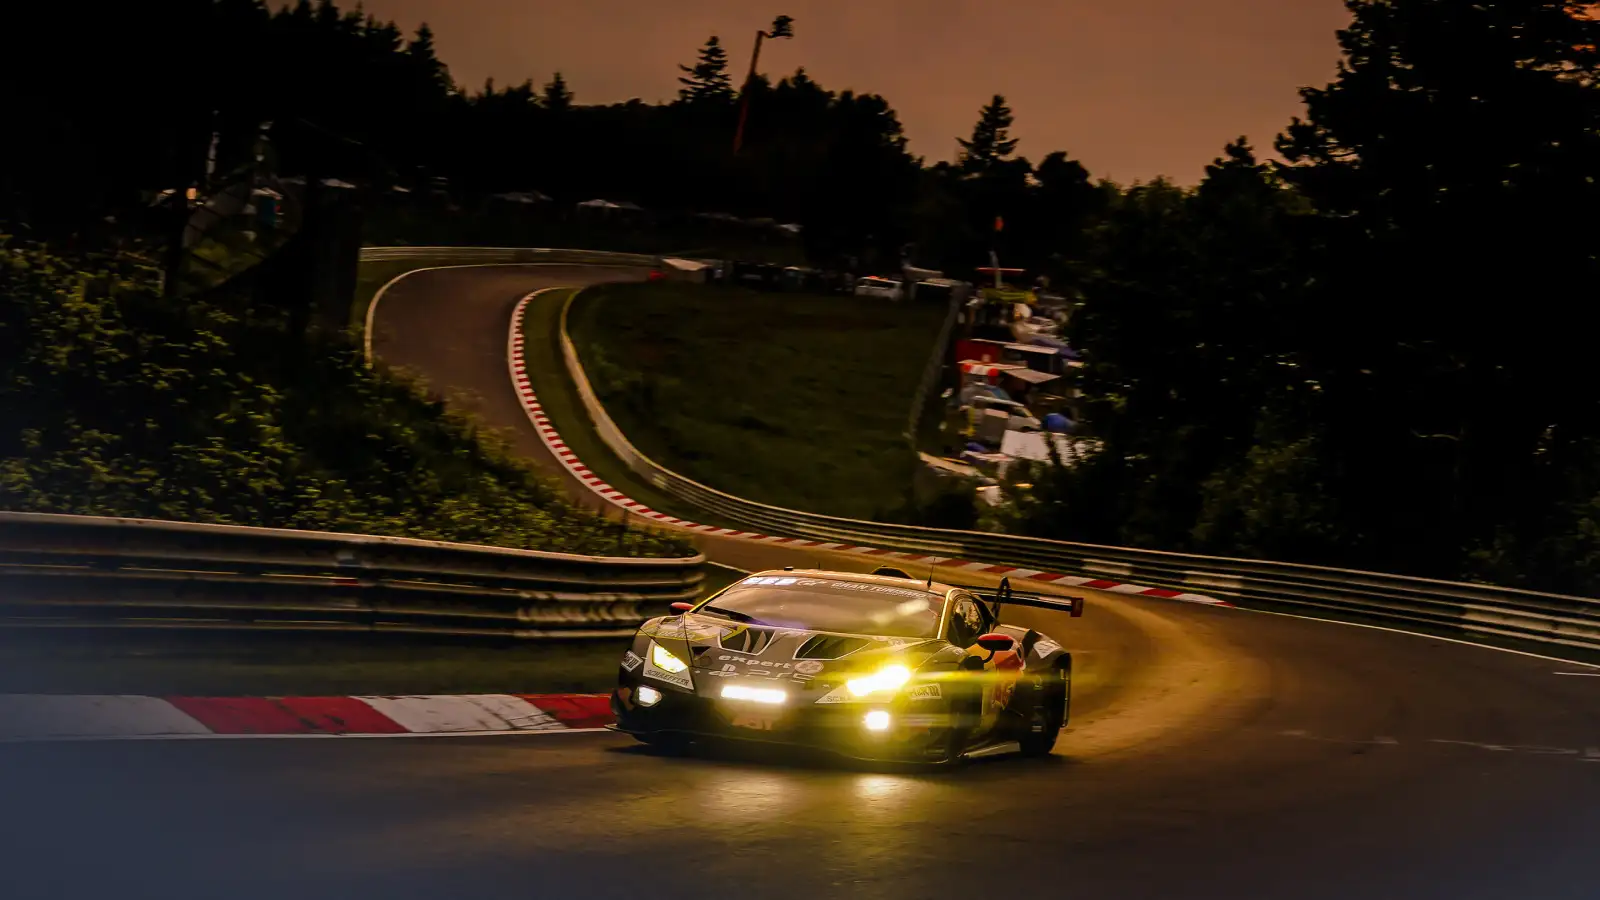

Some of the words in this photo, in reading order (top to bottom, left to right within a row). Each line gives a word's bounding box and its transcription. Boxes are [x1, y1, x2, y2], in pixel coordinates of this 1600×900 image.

[830, 582, 869, 591] GRAN
[718, 654, 792, 669] expert
[645, 669, 690, 687] SCHAEFFLER
